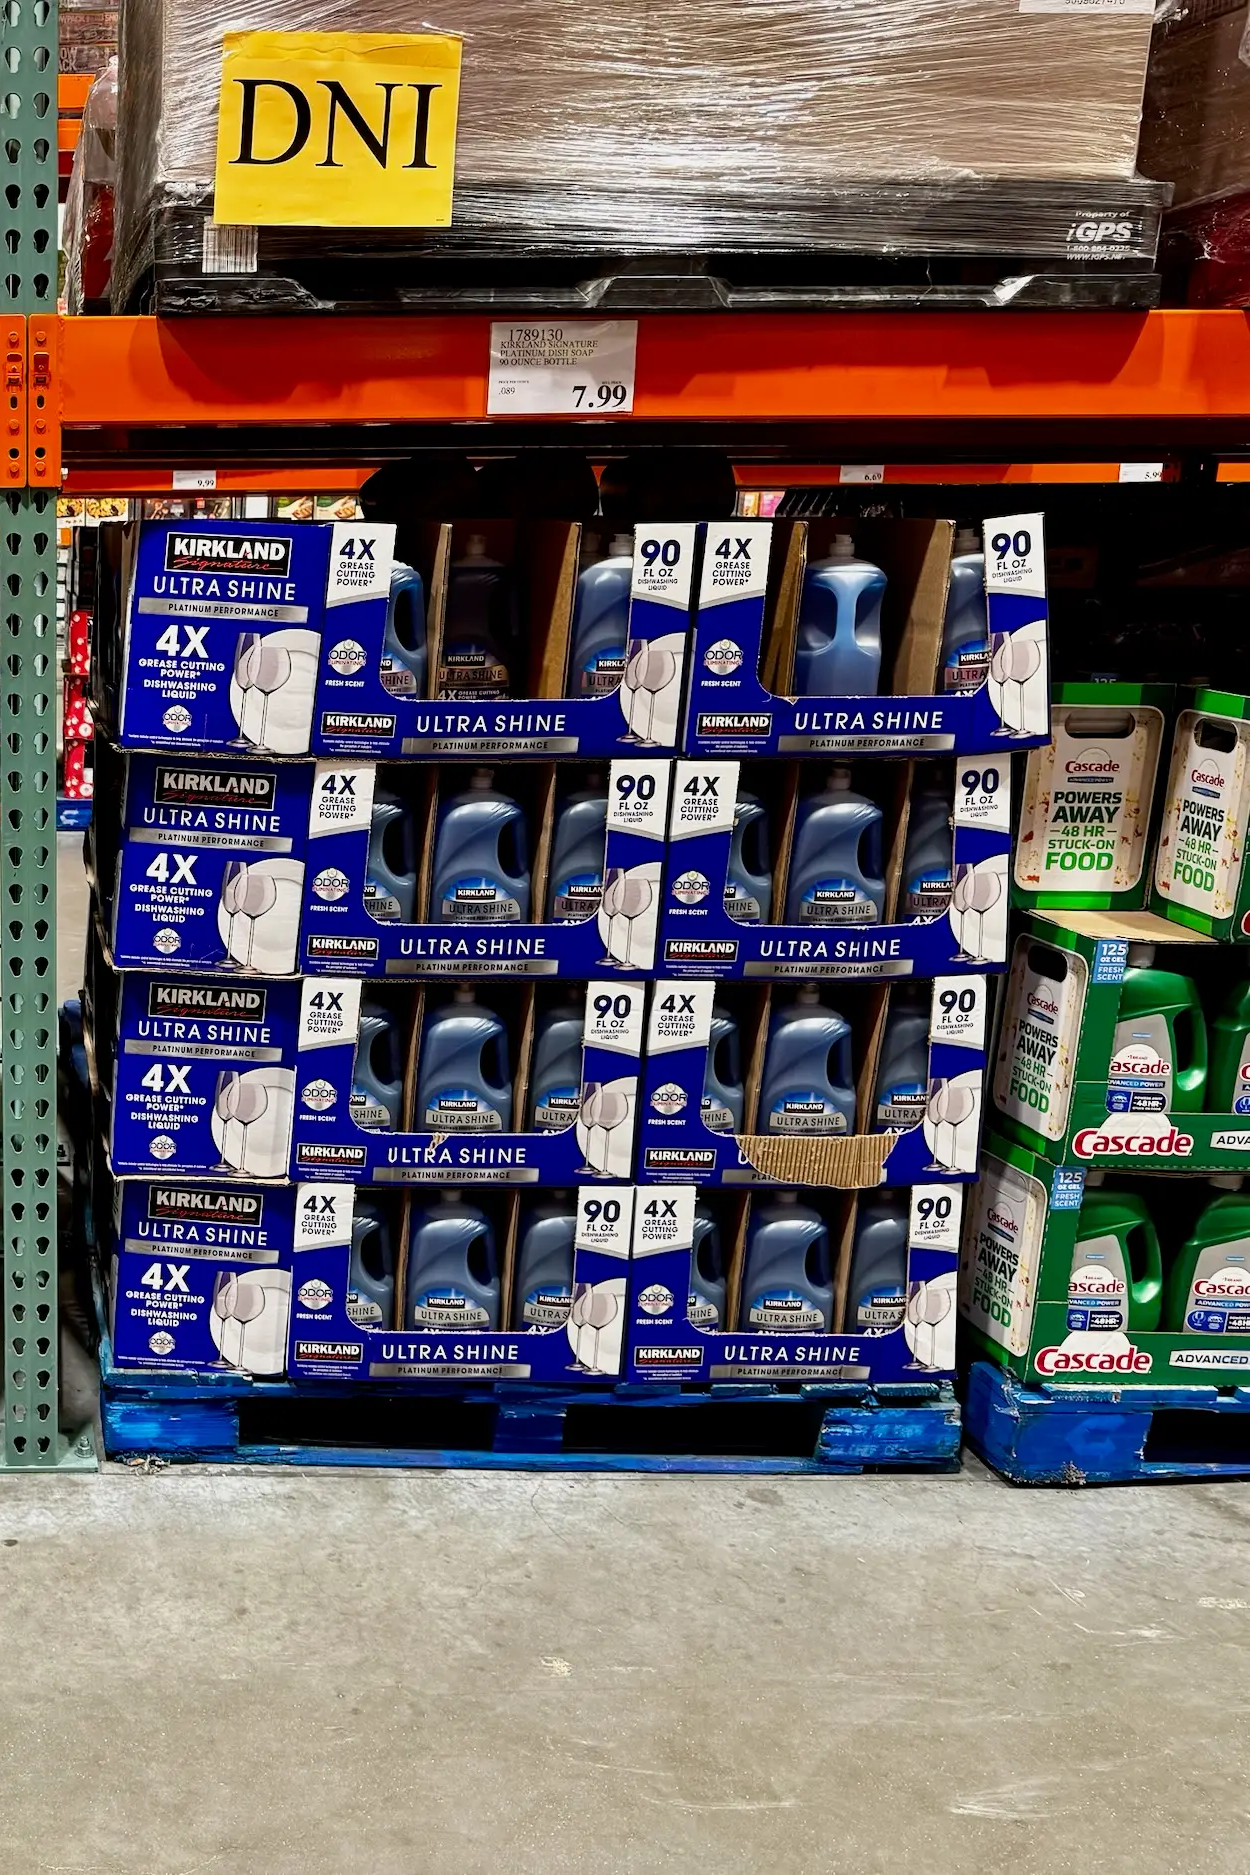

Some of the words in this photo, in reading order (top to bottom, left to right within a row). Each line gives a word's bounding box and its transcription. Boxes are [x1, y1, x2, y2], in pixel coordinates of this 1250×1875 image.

[228, 79, 442, 169] DNI
[1066, 222, 1134, 241] iGPS
[509, 329, 563, 341] 1789130
[548, 340, 598, 348] SIGNATURE
[510, 358, 542, 366] OUNCE
[544, 358, 578, 366] BOTTLE
[572, 385, 627, 408] 7.99
[198, 479, 214, 488] 9.99
[864, 473, 882, 481] 6.69
[174, 538, 286, 561] KIRKLAND
[340, 538, 376, 561] 4X
[991, 530, 1032, 560] 90
[640, 540, 681, 567] 90
[173, 556, 283, 571] Signature
[644, 568, 655, 578] FL
[658, 568, 674, 578] OZ
[154, 576, 220, 597] ULTRA
[227, 580, 296, 601] SHINE
[168, 603, 212, 614] PLATINUM
[214, 606, 279, 618] PERFORMANCE
[156, 624, 210, 658] 4X
[328, 650, 367, 662] ODOR
[138, 658, 178, 668] GREASE
[180, 660, 225, 672] CUTTING
[144, 679, 216, 692] DISHWASHING
[162, 690, 196, 700] LIQUID
[326, 714, 392, 730] KIRKLAND
[417, 716, 488, 732] ULTRA
[494, 714, 566, 732] SHINE
[794, 712, 864, 730] ULTRA
[872, 712, 943, 730] SHINE
[1065, 760, 1120, 774] Cascade
[163, 772, 270, 795] KIRKLAND
[616, 775, 656, 800] 90
[962, 768, 1000, 795] 90
[1054, 791, 1122, 804] POWERS
[1052, 806, 1120, 824] AWAY
[1062, 825, 1078, 837] 48
[1083, 826, 1104, 836] HR
[1048, 839, 1115, 850] STUCK-ON
[1045, 852, 1114, 871] FOOD
[400, 938, 468, 955] ULTRA
[476, 938, 546, 954] SHINE
[760, 940, 828, 958] ULTRA
[836, 939, 901, 957] SHINE
[1102, 944, 1126, 956] 125
[1098, 966, 1124, 974] FRESH
[1072, 1128, 1192, 1158] Cascade
[917, 1196, 952, 1220] 90
[383, 1344, 448, 1360] ULTRA
[454, 1344, 519, 1360] SHINE
[1036, 1345, 1152, 1374] Cascade
[1174, 1353, 1248, 1364] ADVANCED
